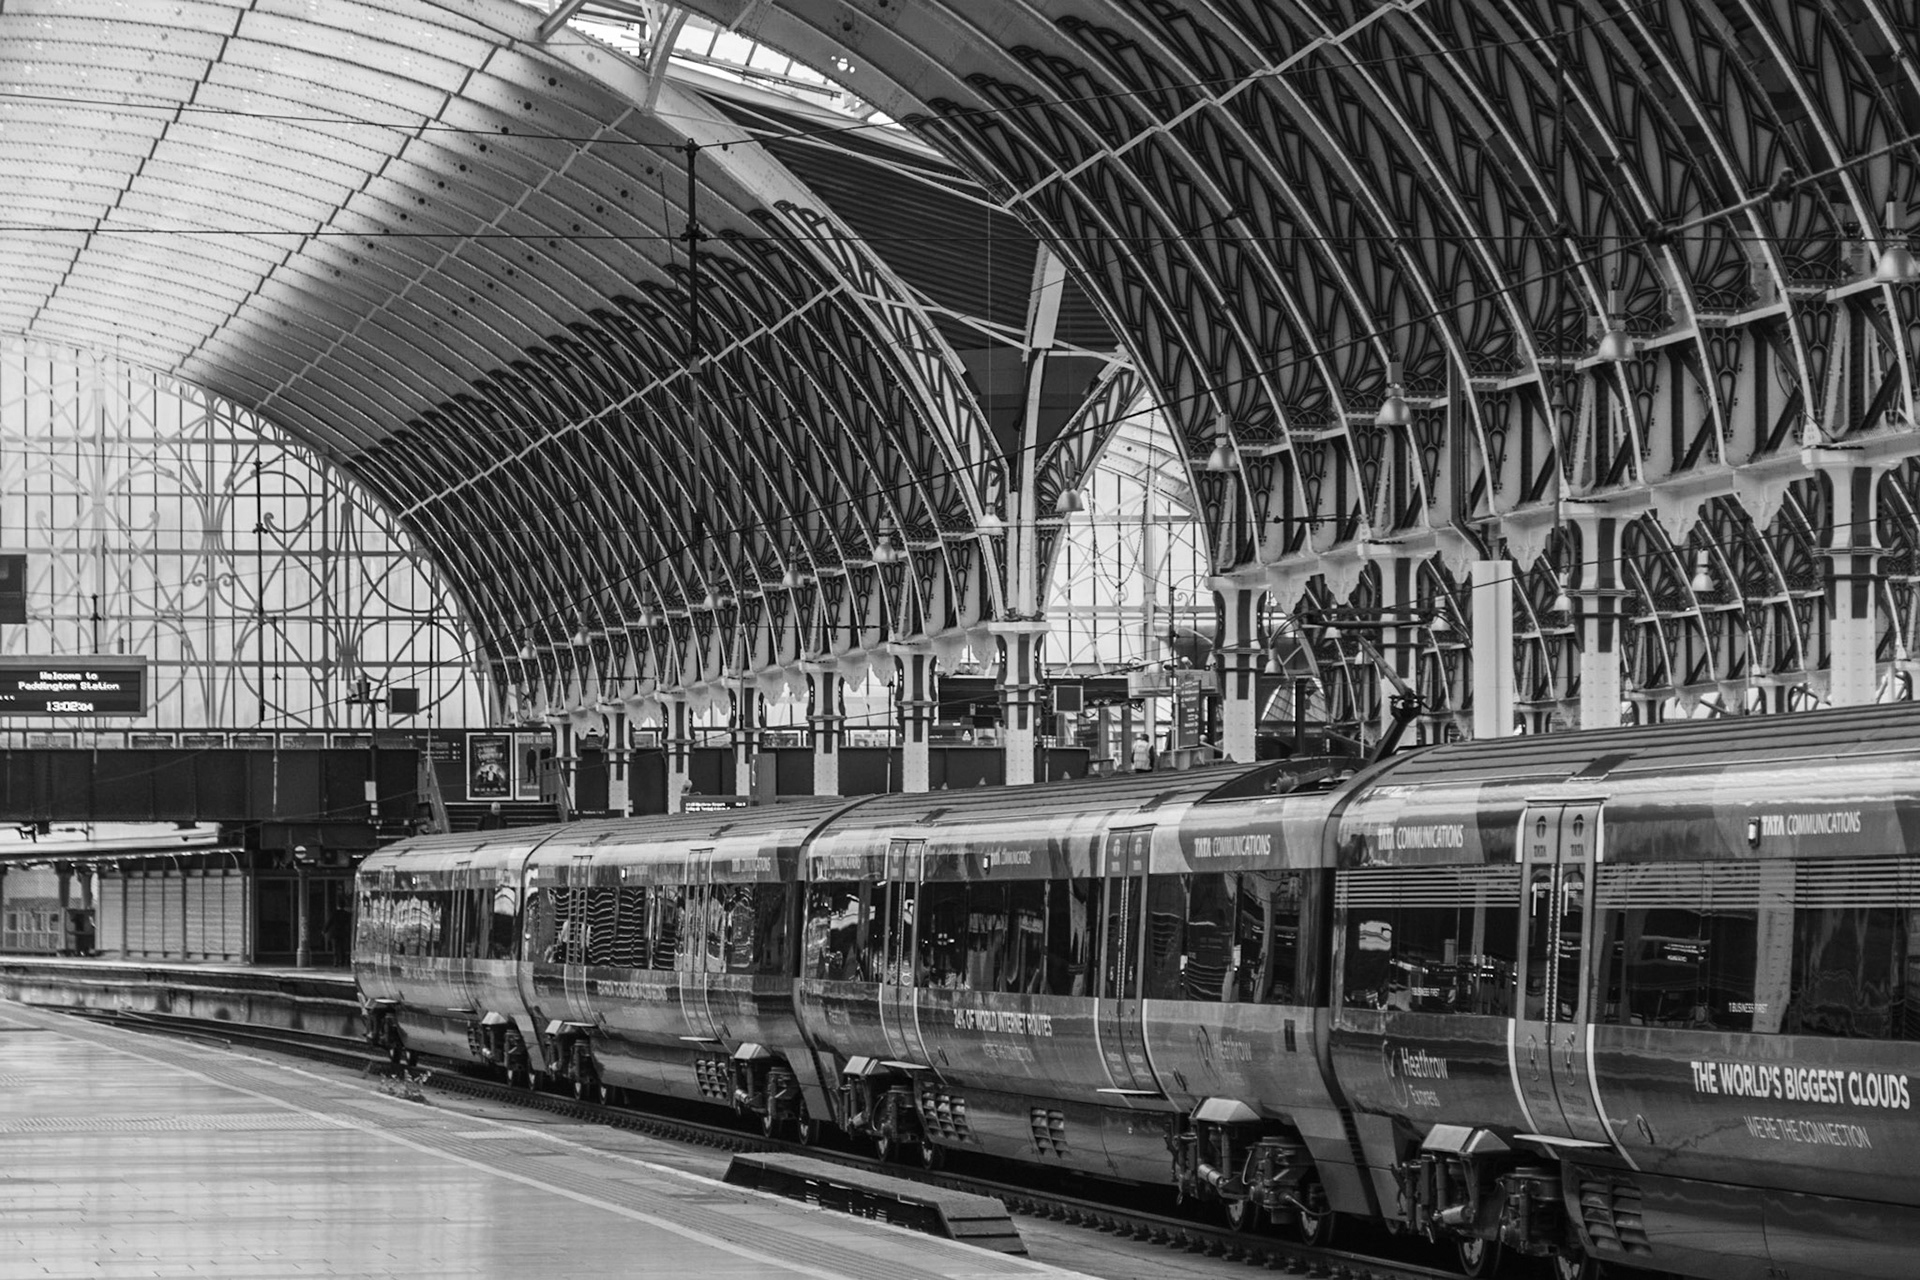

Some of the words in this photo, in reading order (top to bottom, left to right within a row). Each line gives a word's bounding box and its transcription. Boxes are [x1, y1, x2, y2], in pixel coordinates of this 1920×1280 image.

[18, 682, 77, 692] Paddington
[80, 682, 120, 690] Station
[40, 672, 82, 680] Welcome
[86, 672, 98, 680] to
[46, 702, 94, 711] 13:02:04
[1761, 815, 1785, 836] TATA
[1787, 811, 1861, 835] COMMUNICATIONS
[1194, 837, 1212, 858] TATA
[1213, 834, 1271, 857] COMMUNICATIONS
[1378, 827, 1395, 850] TATA
[1397, 824, 1464, 849] COMMUNICATIONS
[975, 1010, 997, 1032] WORLD
[997, 1011, 1027, 1035] INTERNET
[1027, 1013, 1053, 1037] ROUTES
[1400, 1047, 1449, 1079] Heathrow
[1408, 1084, 1441, 1110] Express
[1691, 1061, 1719, 1094] THE
[1719, 1063, 1783, 1100] WORLD'S
[1783, 1067, 1845, 1104] BIGGEST
[1848, 1071, 1911, 1110] CLOUDS
[1776, 1119, 1801, 1142] THE
[1799, 1120, 1873, 1149] CONNECTION
